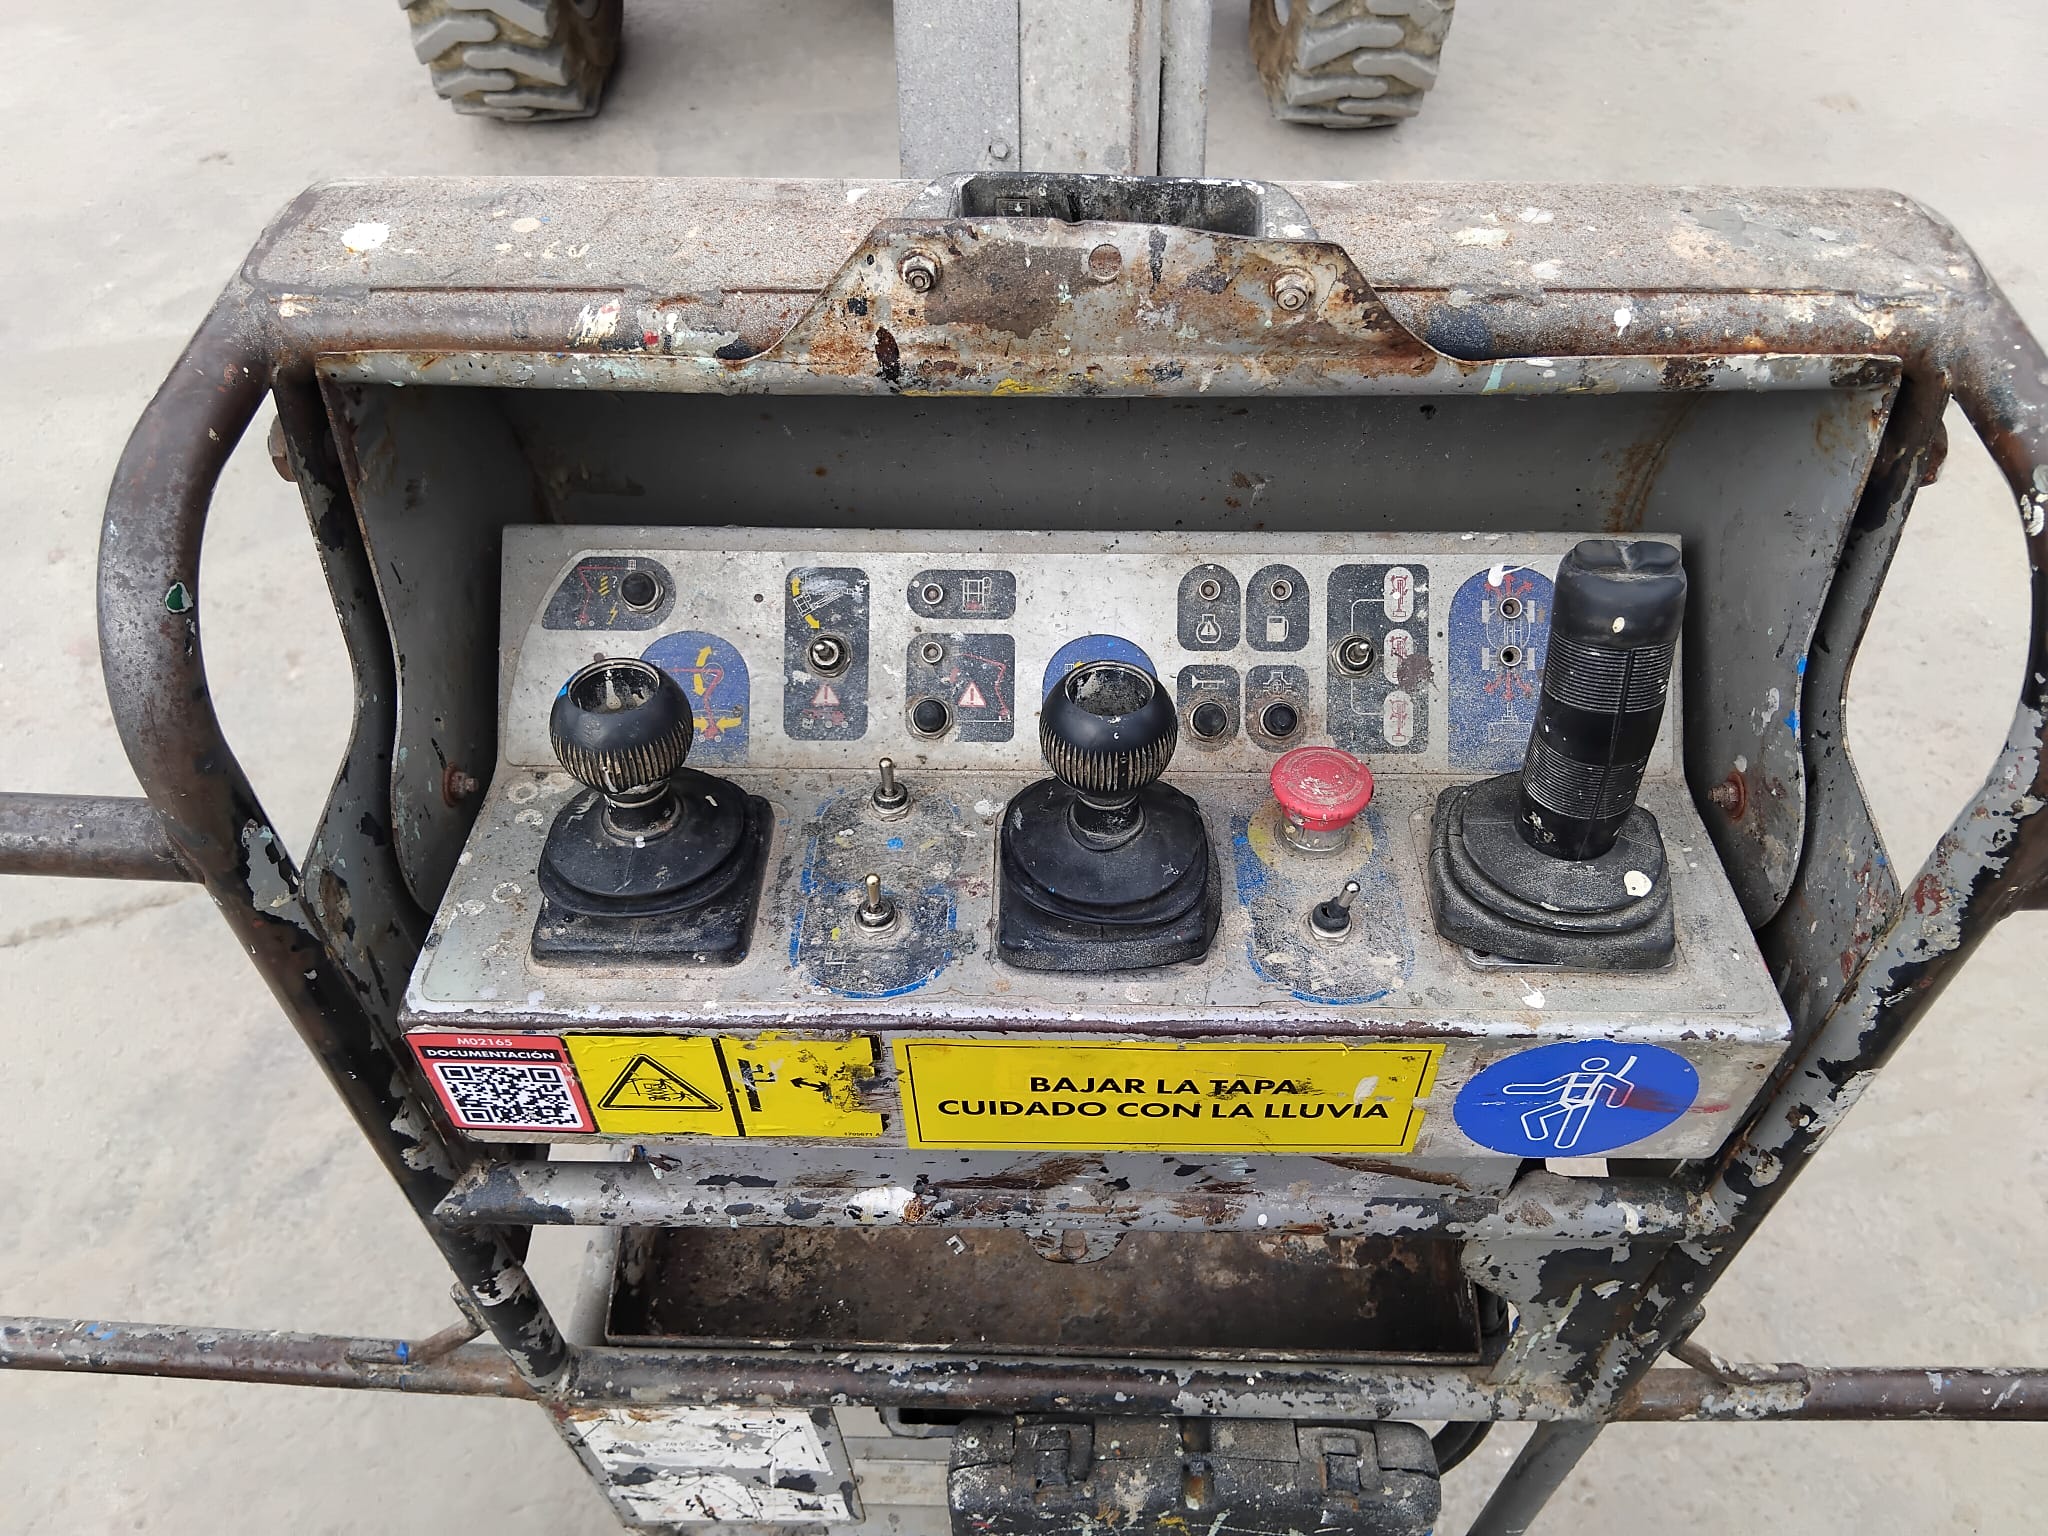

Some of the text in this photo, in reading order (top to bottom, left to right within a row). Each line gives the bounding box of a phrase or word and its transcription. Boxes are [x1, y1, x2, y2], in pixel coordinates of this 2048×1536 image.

[456, 1037, 513, 1046] M02165
[426, 1049, 556, 1059] DOCUMENTACIÓN
[1030, 1077, 1299, 1095] BAJAR LA TAPA
[938, 1100, 1389, 1119] CUIDADO CON LA LLUVIA
